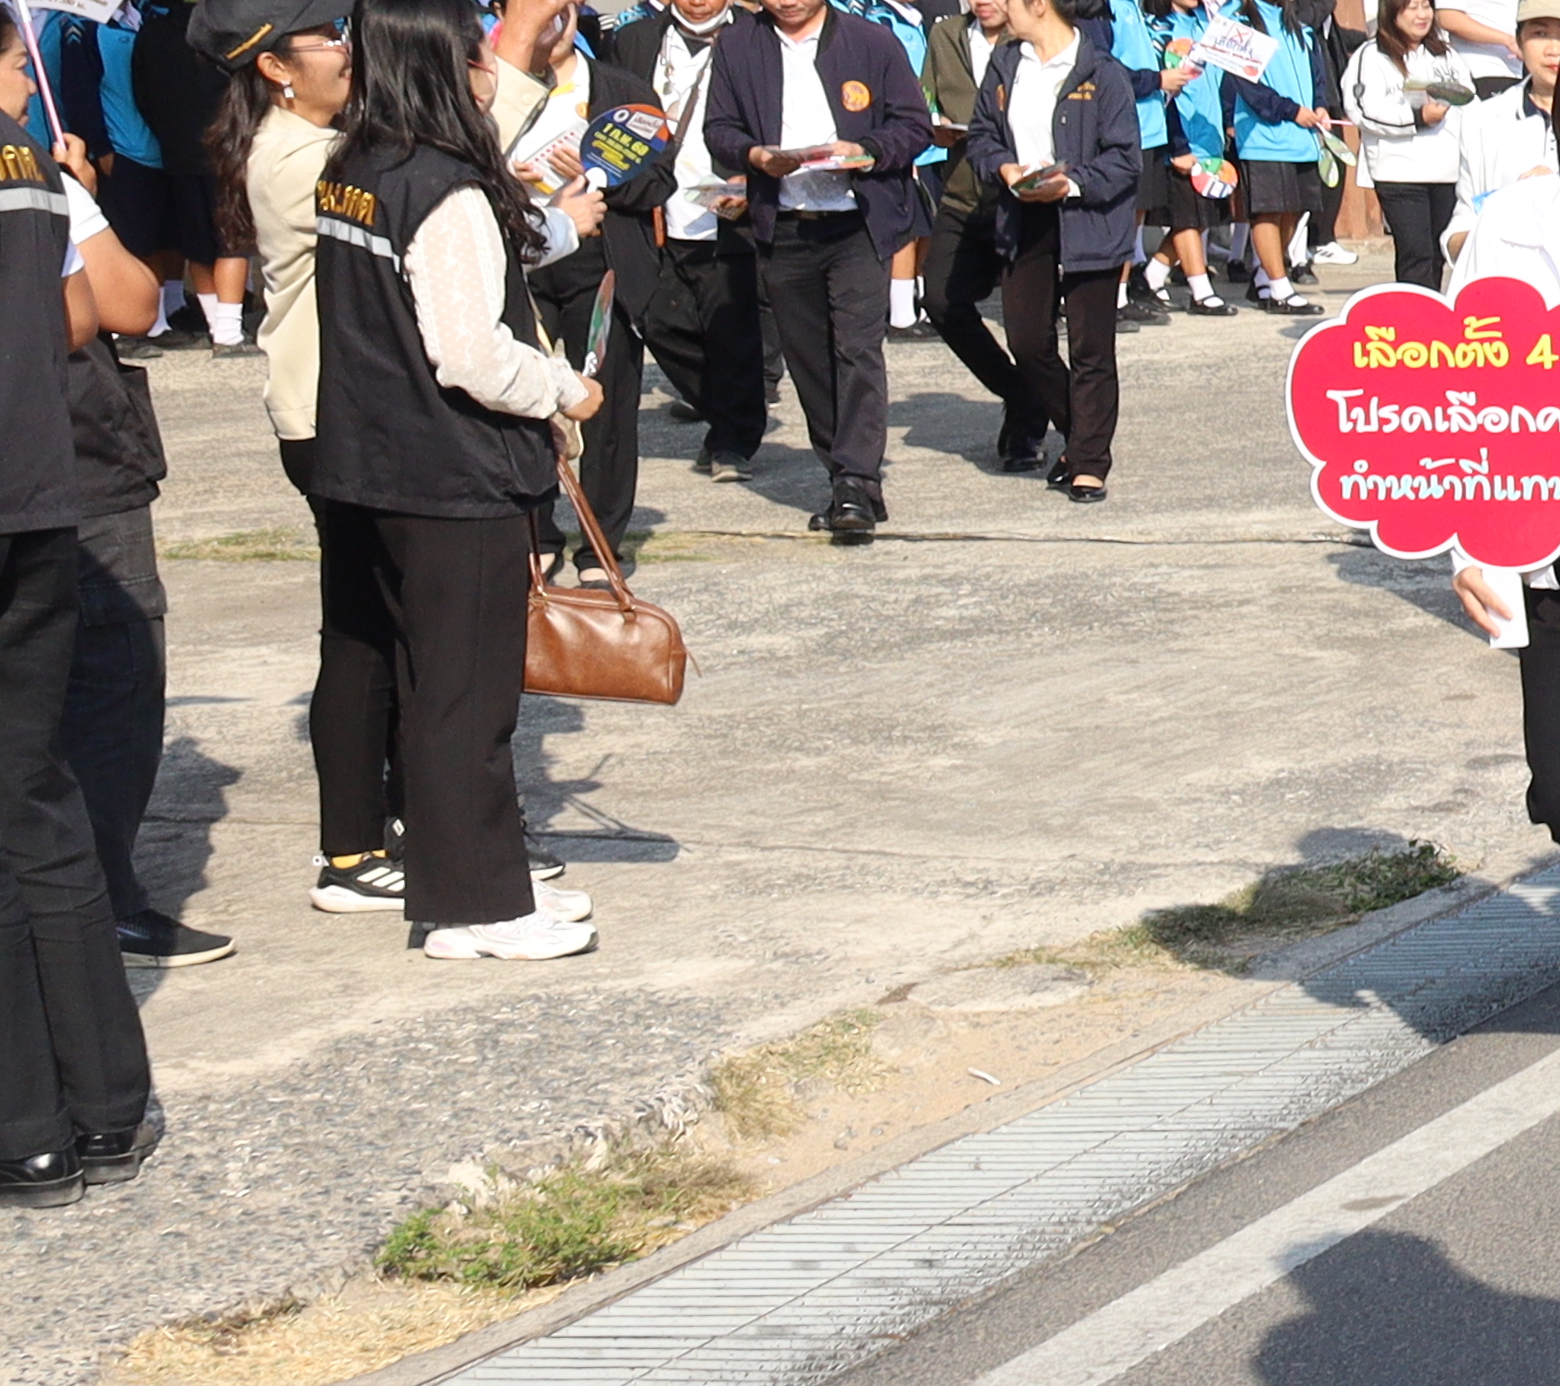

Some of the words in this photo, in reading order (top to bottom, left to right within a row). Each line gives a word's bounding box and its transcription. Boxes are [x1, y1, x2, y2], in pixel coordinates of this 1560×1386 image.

[1352, 316, 1509, 370] เลือกตั้ง
[1525, 333, 1560, 370] 4
